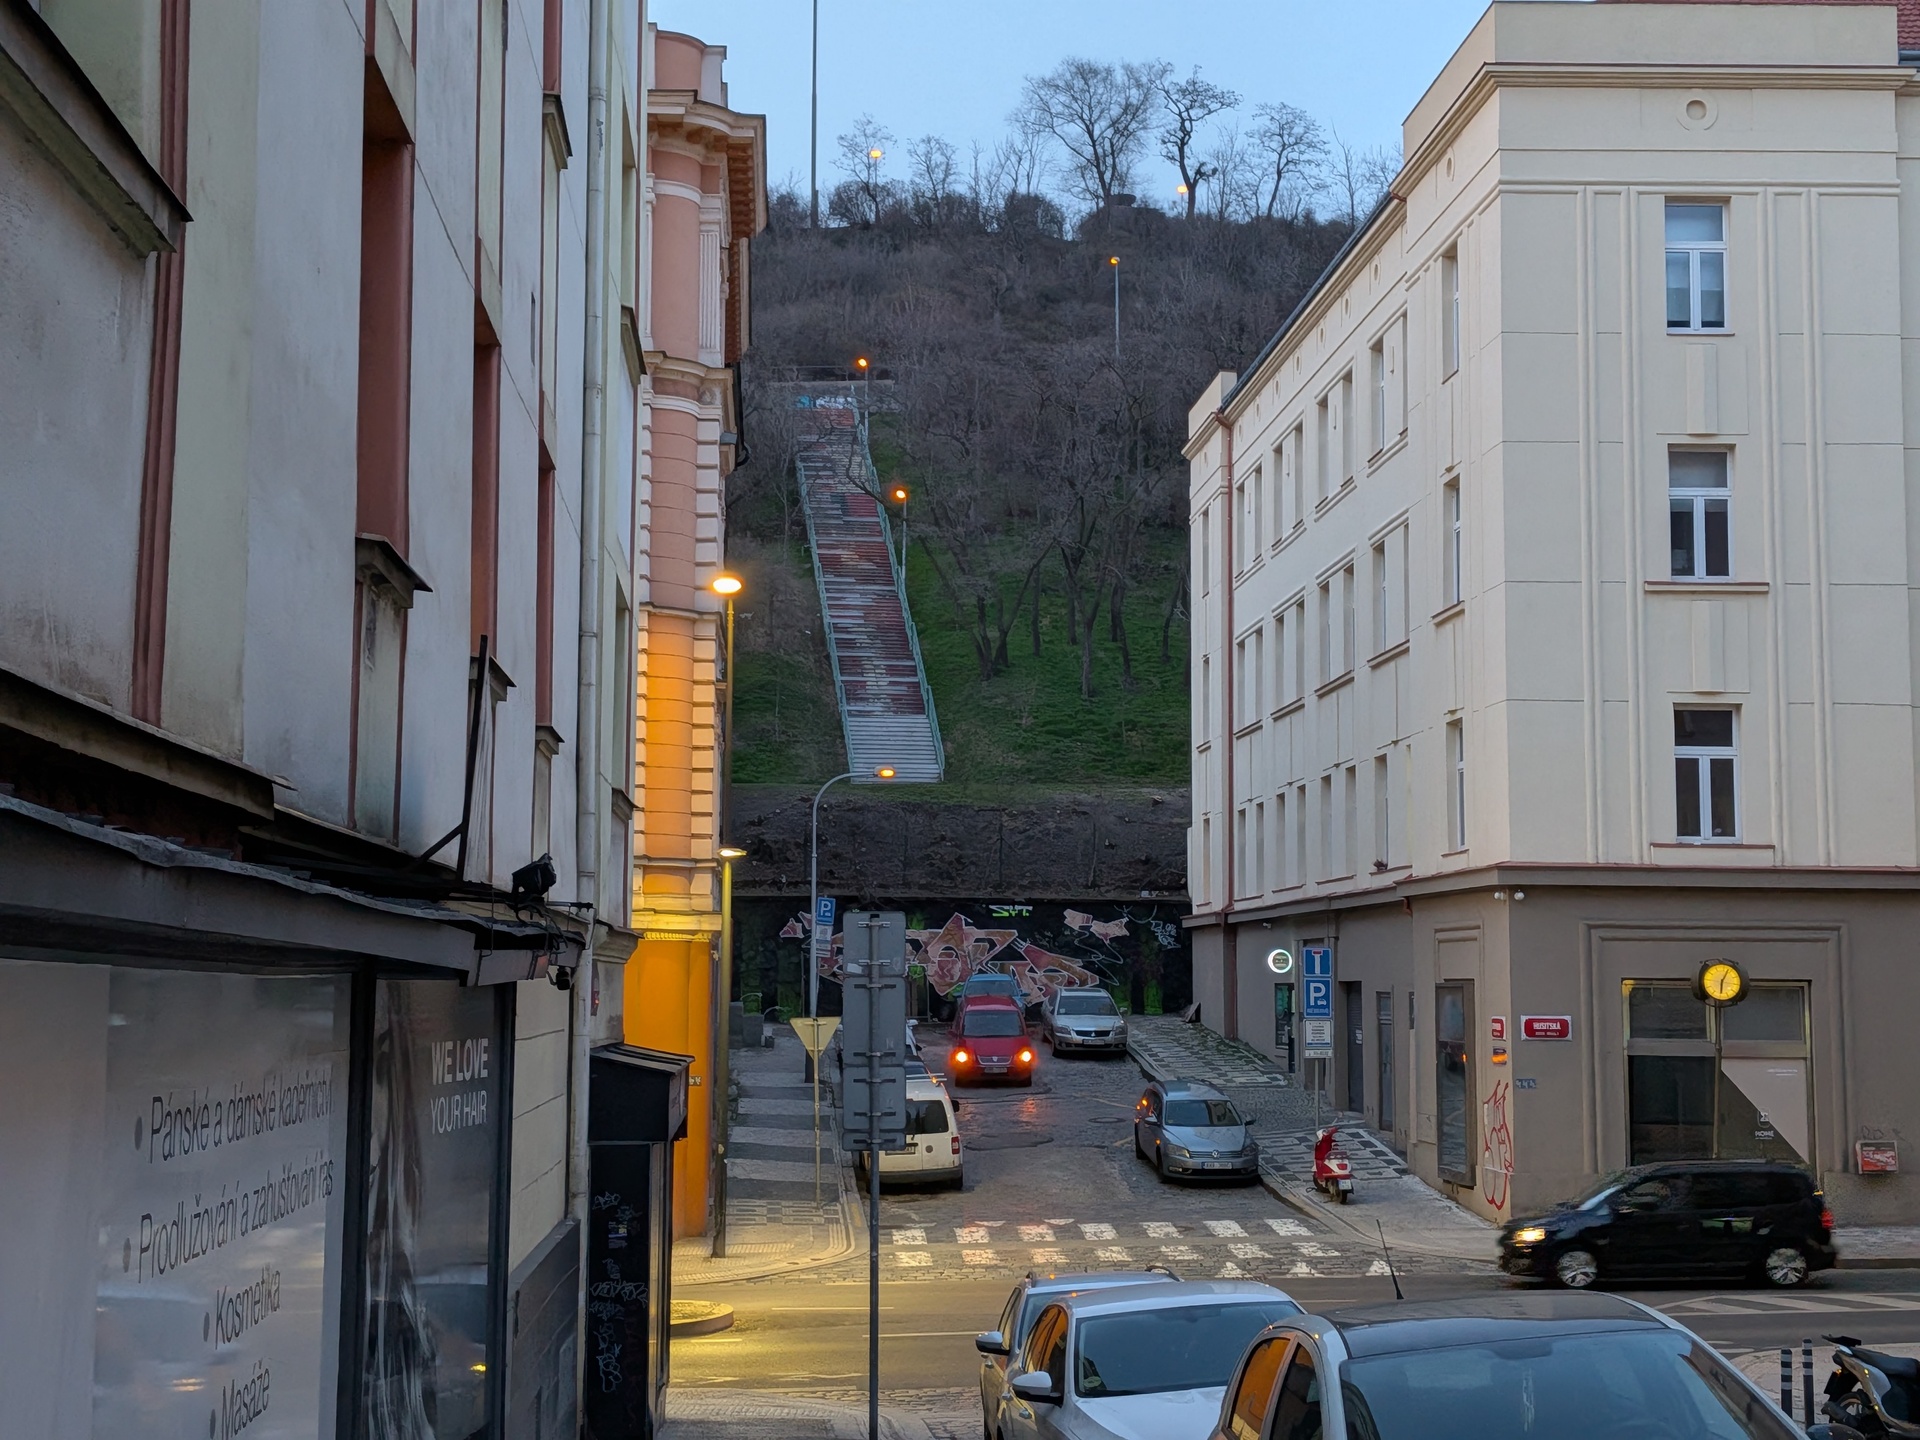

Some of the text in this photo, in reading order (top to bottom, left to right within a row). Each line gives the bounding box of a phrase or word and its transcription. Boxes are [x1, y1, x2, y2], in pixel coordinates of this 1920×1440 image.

[820, 901, 831, 916] P
[1310, 983, 1326, 1006] P
[431, 1038, 488, 1085] WE LOVE
[149, 1086, 210, 1164] Pánské
[213, 1100, 223, 1147] a
[227, 1075, 276, 1143] dámské
[430, 1090, 488, 1135] YOUR HAIR
[138, 1180, 239, 1283] Prodlužování
[240, 1193, 249, 1237] a
[215, 1263, 281, 1350] Kosmetika
[221, 1358, 271, 1440] Masáže
